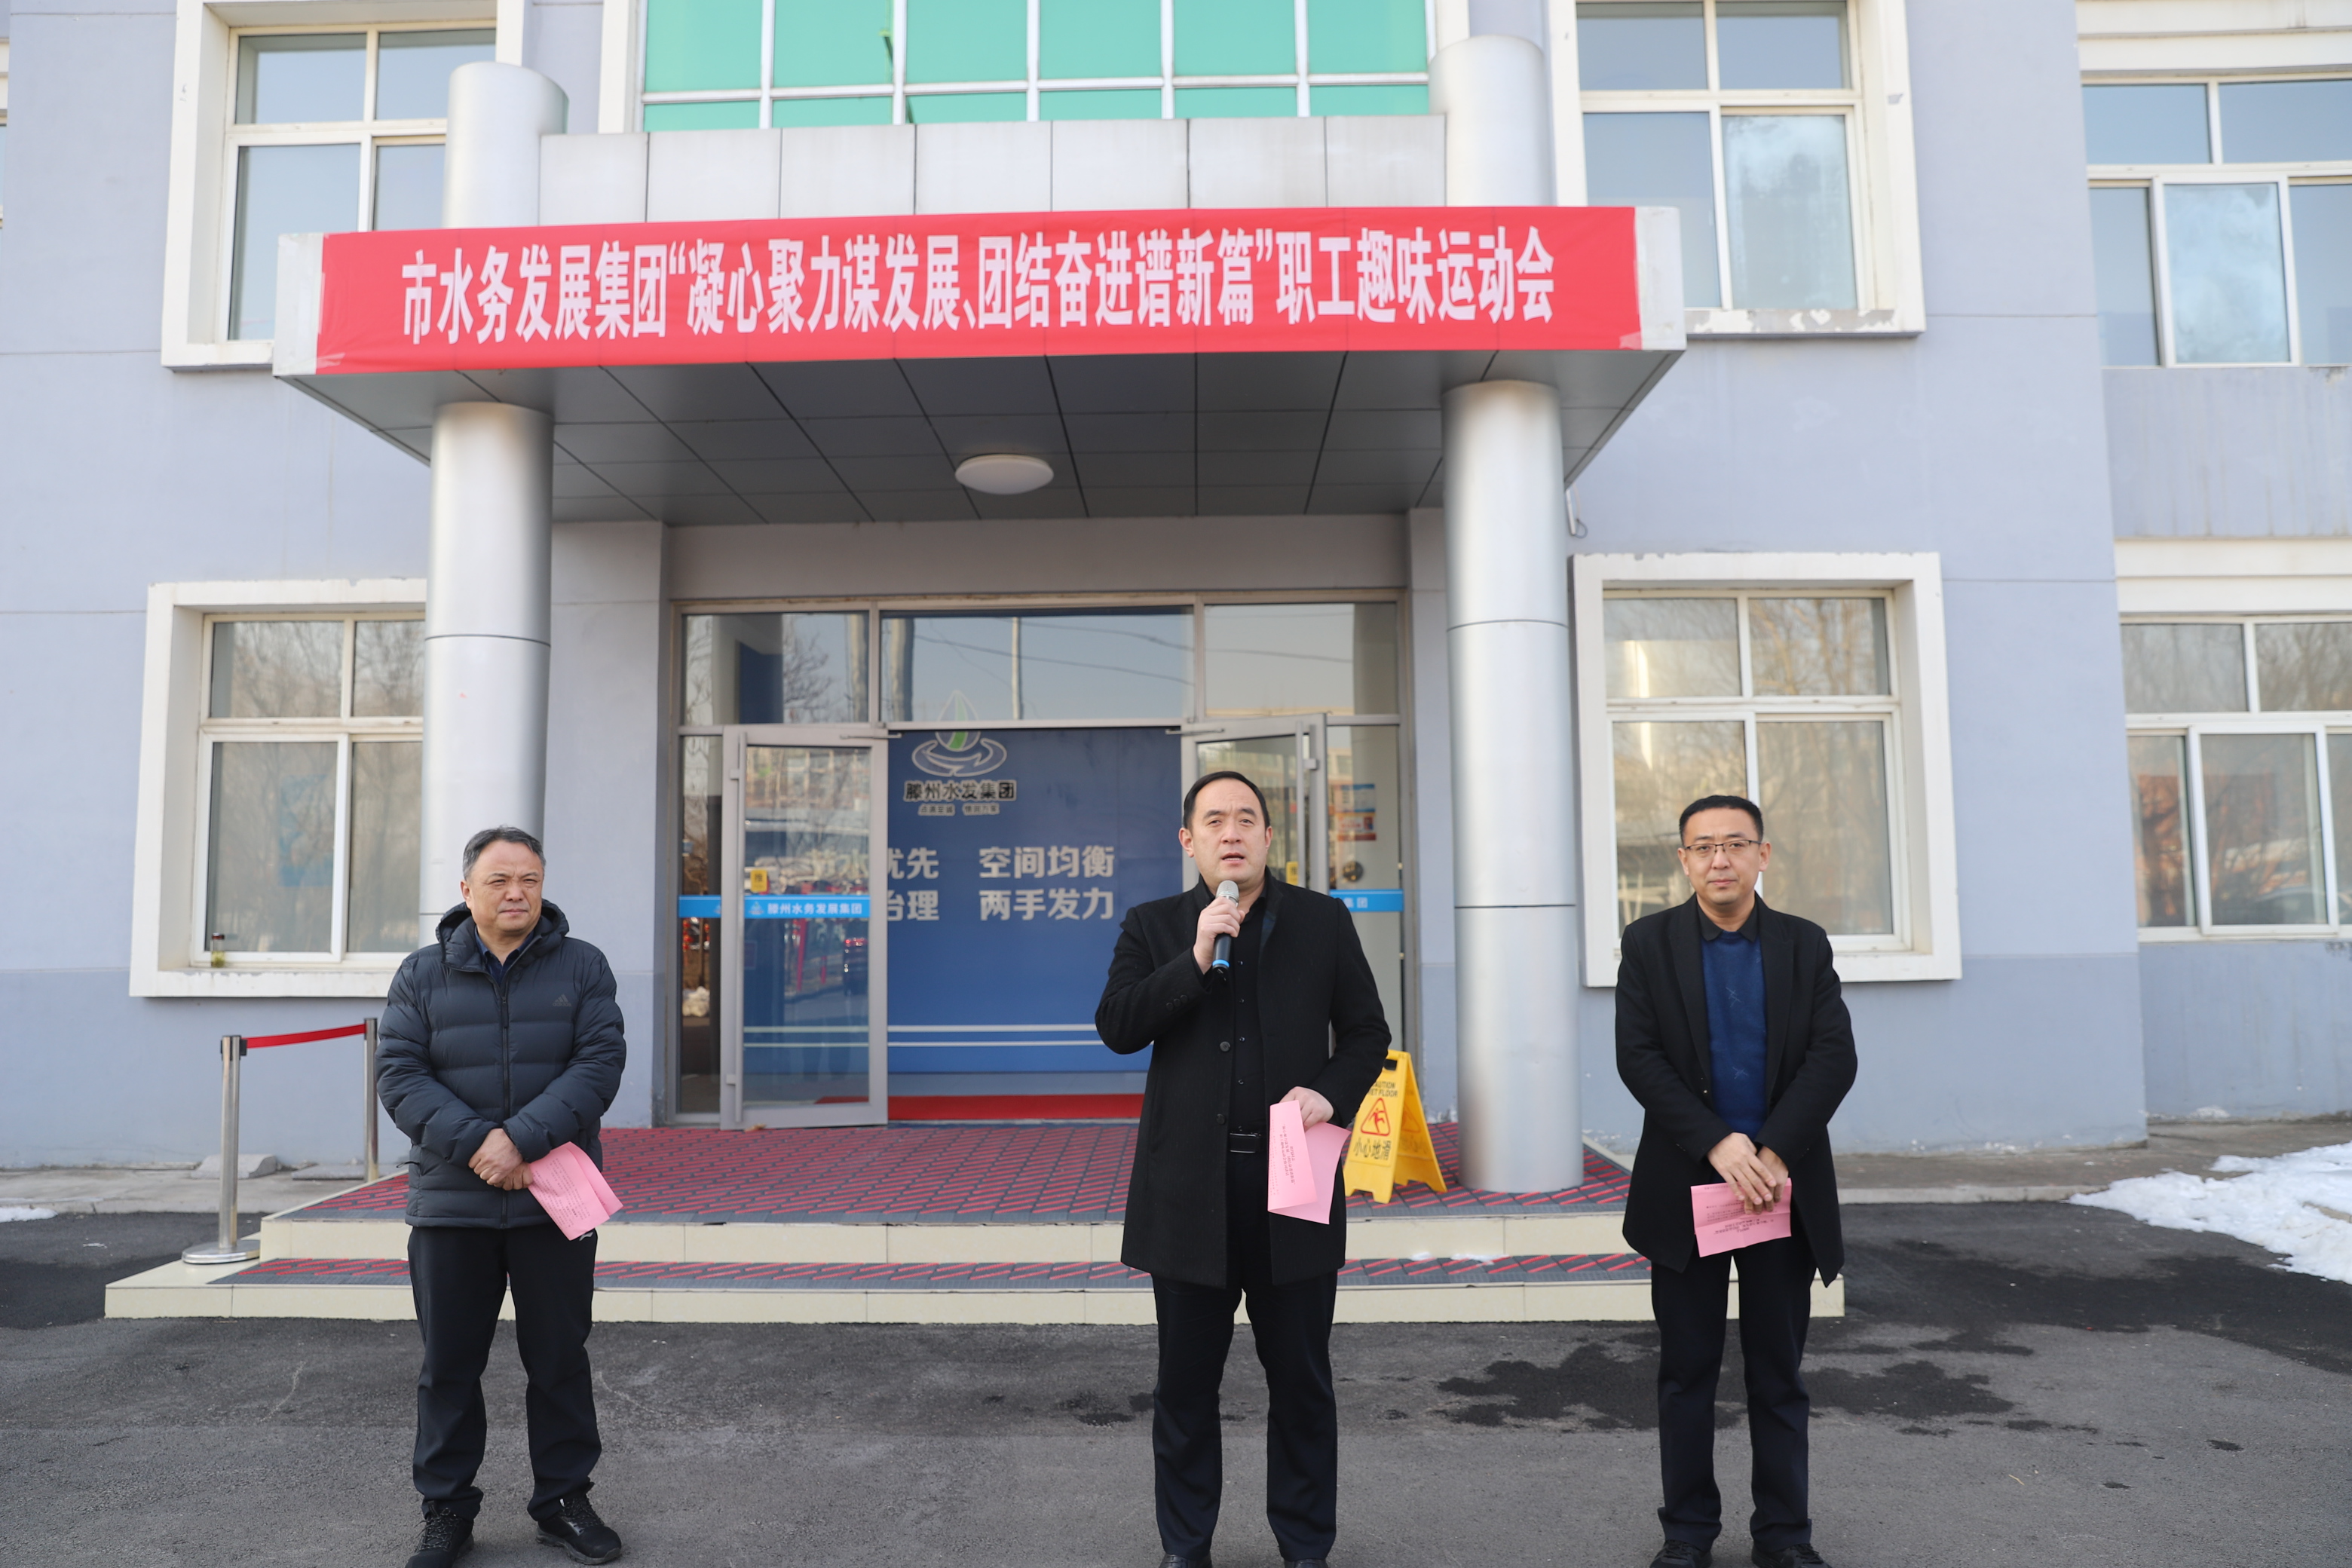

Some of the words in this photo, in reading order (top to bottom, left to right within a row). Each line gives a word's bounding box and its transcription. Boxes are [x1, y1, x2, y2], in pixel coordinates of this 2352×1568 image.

[905, 781, 1015, 800] 滕州水发集团
[978, 845, 1114, 879] 空间均衡
[767, 903, 862, 915] 滕州水务发展集团
[978, 888, 1114, 921] 两手发力
[1380, 1089, 1398, 1098] FLOOR
[1354, 1137, 1392, 1161] 小心地滑
